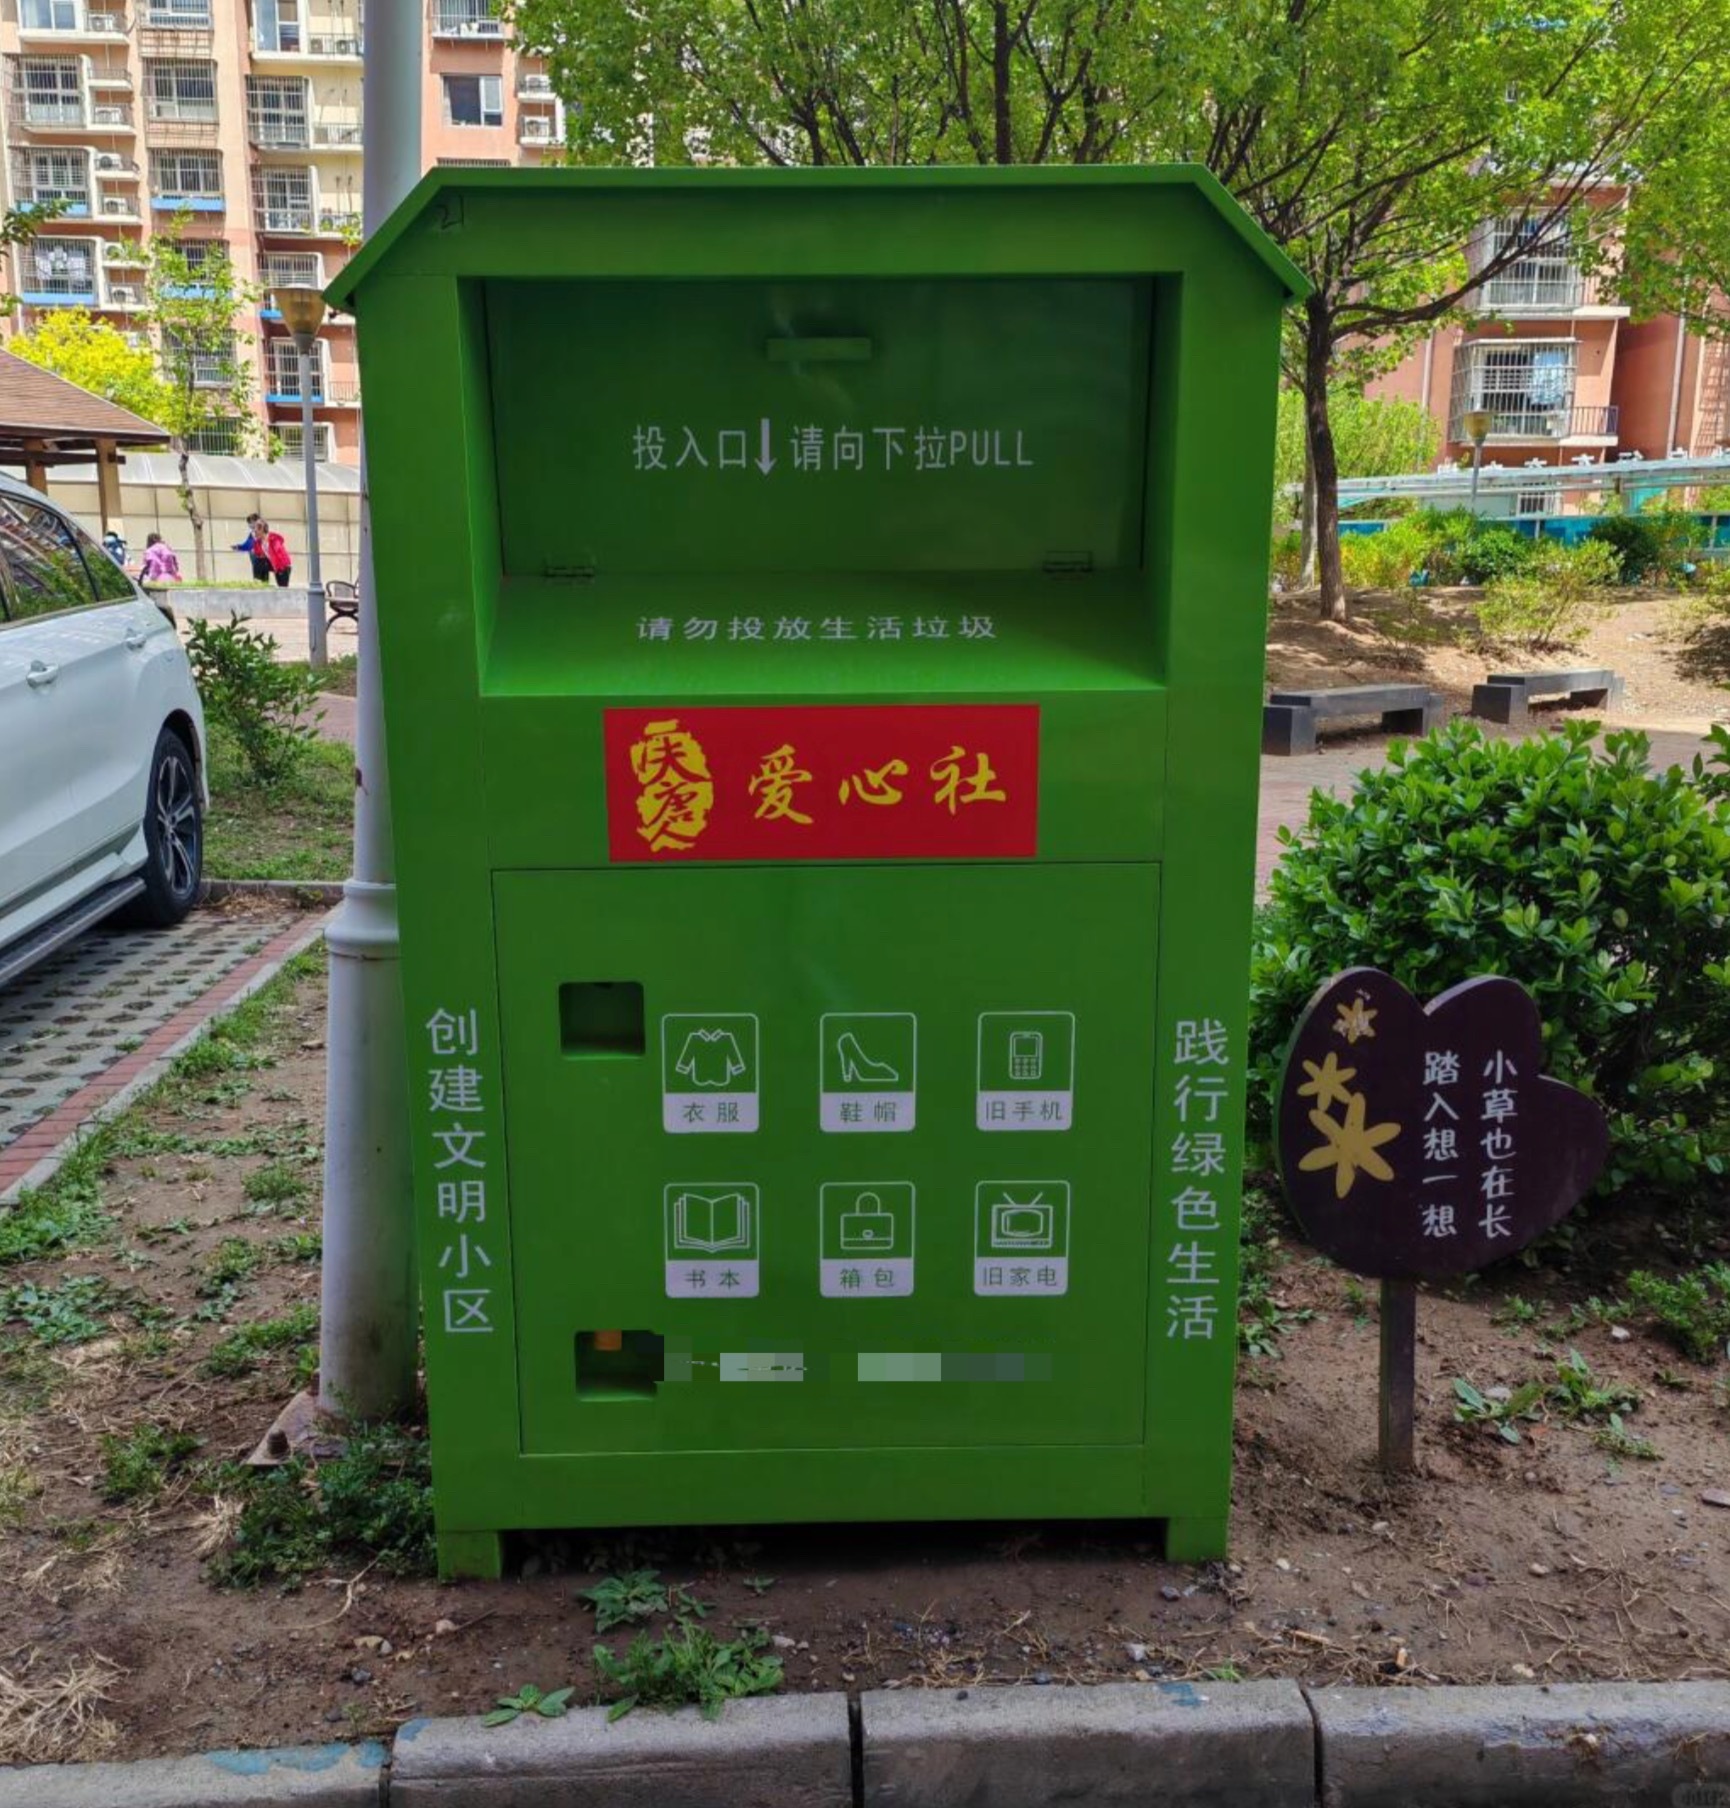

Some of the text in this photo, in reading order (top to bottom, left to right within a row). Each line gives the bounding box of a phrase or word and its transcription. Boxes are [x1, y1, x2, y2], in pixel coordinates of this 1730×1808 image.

[632, 424, 747, 470] 投入口
[636, 615, 997, 641] 请勿投放生活垃圾
[747, 744, 1007, 824] 爱心社
[683, 1102, 740, 1123] 衣服
[840, 1102, 897, 1123] 鞋帽
[984, 1100, 1063, 1122] 旧手机
[1421, 1050, 1462, 1238] 踏入想一想
[1478, 1050, 1518, 1239] 小草也在长
[426, 1007, 495, 1333] 创建文明小区
[1166, 1018, 1230, 1340] 践行绿色生活
[685, 1269, 741, 1289] 书本
[839, 1269, 896, 1290] 箱包
[982, 1266, 1057, 1287] 旧家电
